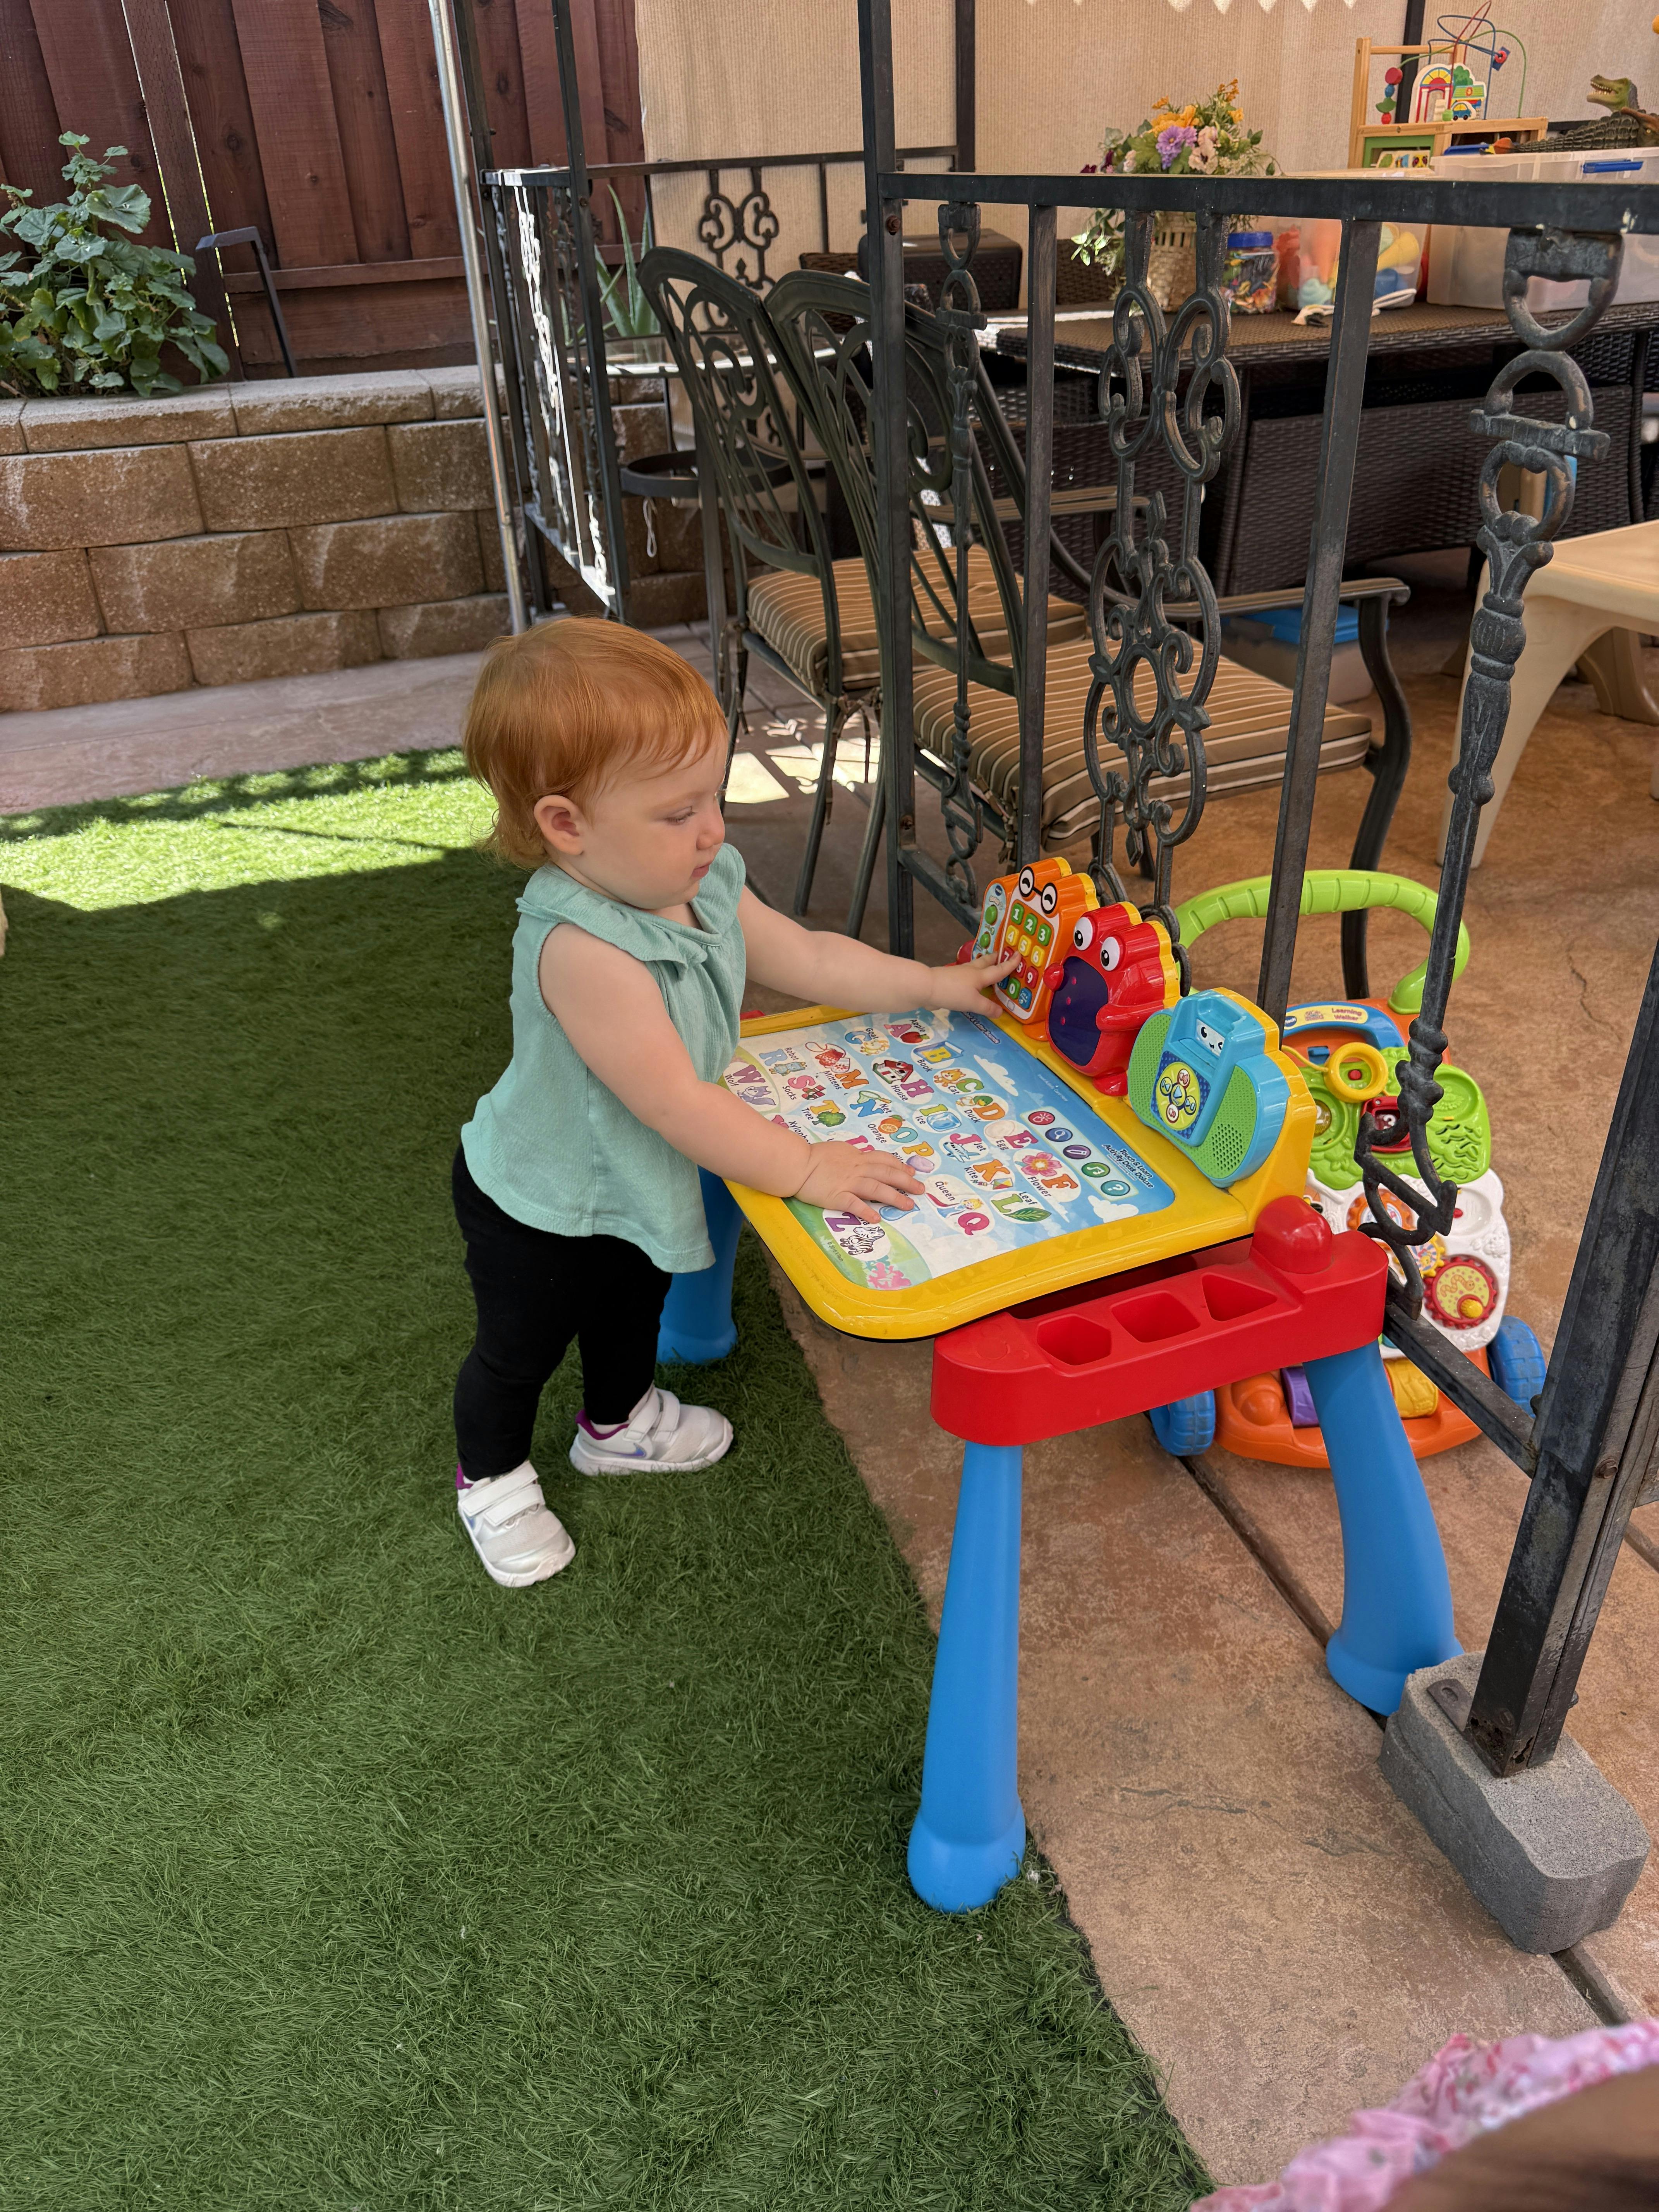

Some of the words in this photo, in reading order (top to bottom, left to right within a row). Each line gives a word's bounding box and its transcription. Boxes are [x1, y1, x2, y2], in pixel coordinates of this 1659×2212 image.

[1013, 908, 1020, 921] 1
[1025, 919, 1033, 932] 2
[1008, 931, 1015, 943] 4
[1039, 929, 1046, 942] 3
[1020, 941, 1027, 952] 5
[1004, 951, 1010, 962] 7
[1033, 951, 1039, 963] 6
[1027, 972, 1033, 983] 9
[1009, 983, 1015, 994] 0
[1331, 1007, 1362, 1017] Learning
[883, 1024, 912, 1038] A
[910, 1019, 926, 1033] Apple
[866, 1028, 879, 1039] Goat
[759, 1048, 788, 1066] R
[785, 1047, 799, 1060] Robot
[921, 1047, 951, 1062] B
[917, 1059, 933, 1072] Book
[725, 1074, 739, 1087] Wolf
[733, 1065, 766, 1083] W
[823, 1070, 842, 1090] Mittens
[835, 1069, 869, 1089] M
[788, 1075, 816, 1089] S
[900, 1079, 934, 1097] H
[956, 1078, 984, 1092] C
[782, 1085, 797, 1100] Socks
[891, 1085, 908, 1101] House
[948, 1085, 959, 1095] Cat
[802, 1108, 814, 1120] Tree
[810, 1100, 840, 1114] T
[849, 1099, 884, 1117] N
[880, 1103, 892, 1113] Net
[919, 1104, 948, 1116] I
[972, 1103, 1005, 1120] D
[915, 1116, 926, 1125] Ice
[964, 1109, 981, 1123] Duck
[868, 1124, 887, 1143] Orange
[889, 1127, 918, 1143] O
[950, 1133, 982, 1145] J
[1003, 1130, 1039, 1149] E
[902, 1141, 934, 1156] P
[974, 1142, 986, 1152] Jet
[996, 1140, 1009, 1151] Egg
[973, 1159, 1010, 1182] K
[1103, 1144, 1124, 1162] Activity
[1122, 1161, 1137, 1172] Desk
[1134, 1171, 1154, 1188] Deluxe
[1120, 1149, 1135, 1163] Touch
[1137, 1165, 1152, 1178] Learn
[964, 1166, 978, 1179] Kite
[1027, 1176, 1052, 1197] Flower
[1041, 1173, 1079, 1189] F
[935, 1181, 955, 1201] Queen
[991, 1194, 1023, 1213] L
[1018, 1191, 1038, 1206] Leaf
[825, 1211, 862, 1232] Z
[958, 1212, 990, 1235] Q
